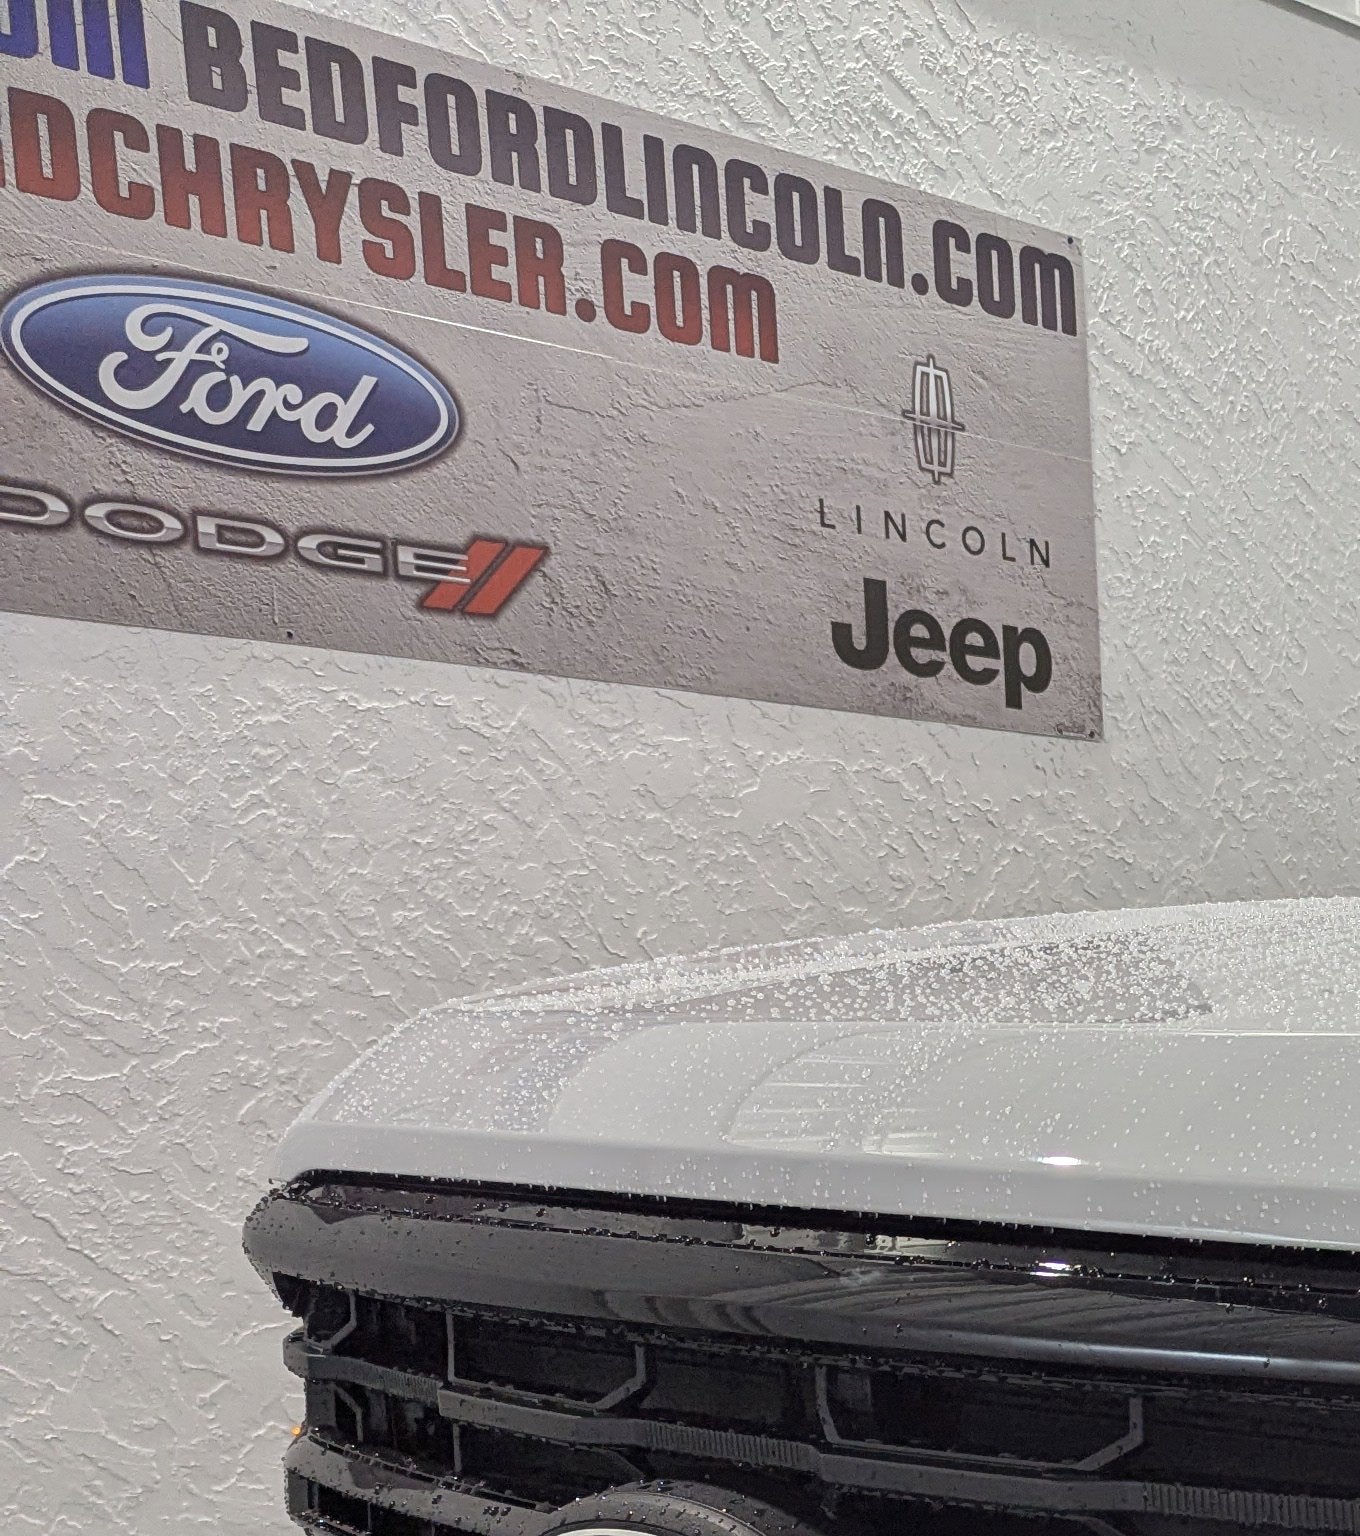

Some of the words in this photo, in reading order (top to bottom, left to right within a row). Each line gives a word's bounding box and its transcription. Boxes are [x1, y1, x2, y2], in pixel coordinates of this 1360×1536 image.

[0, 86, 779, 365] DCHRYSLER.COM
[180, 0, 1078, 338] BEDFORDLINCOLN.COM
[97, 303, 376, 450] Ford
[0, 485, 472, 583] DODGE
[817, 498, 1052, 568] LINCOLN
[831, 577, 1053, 710] Jeep
